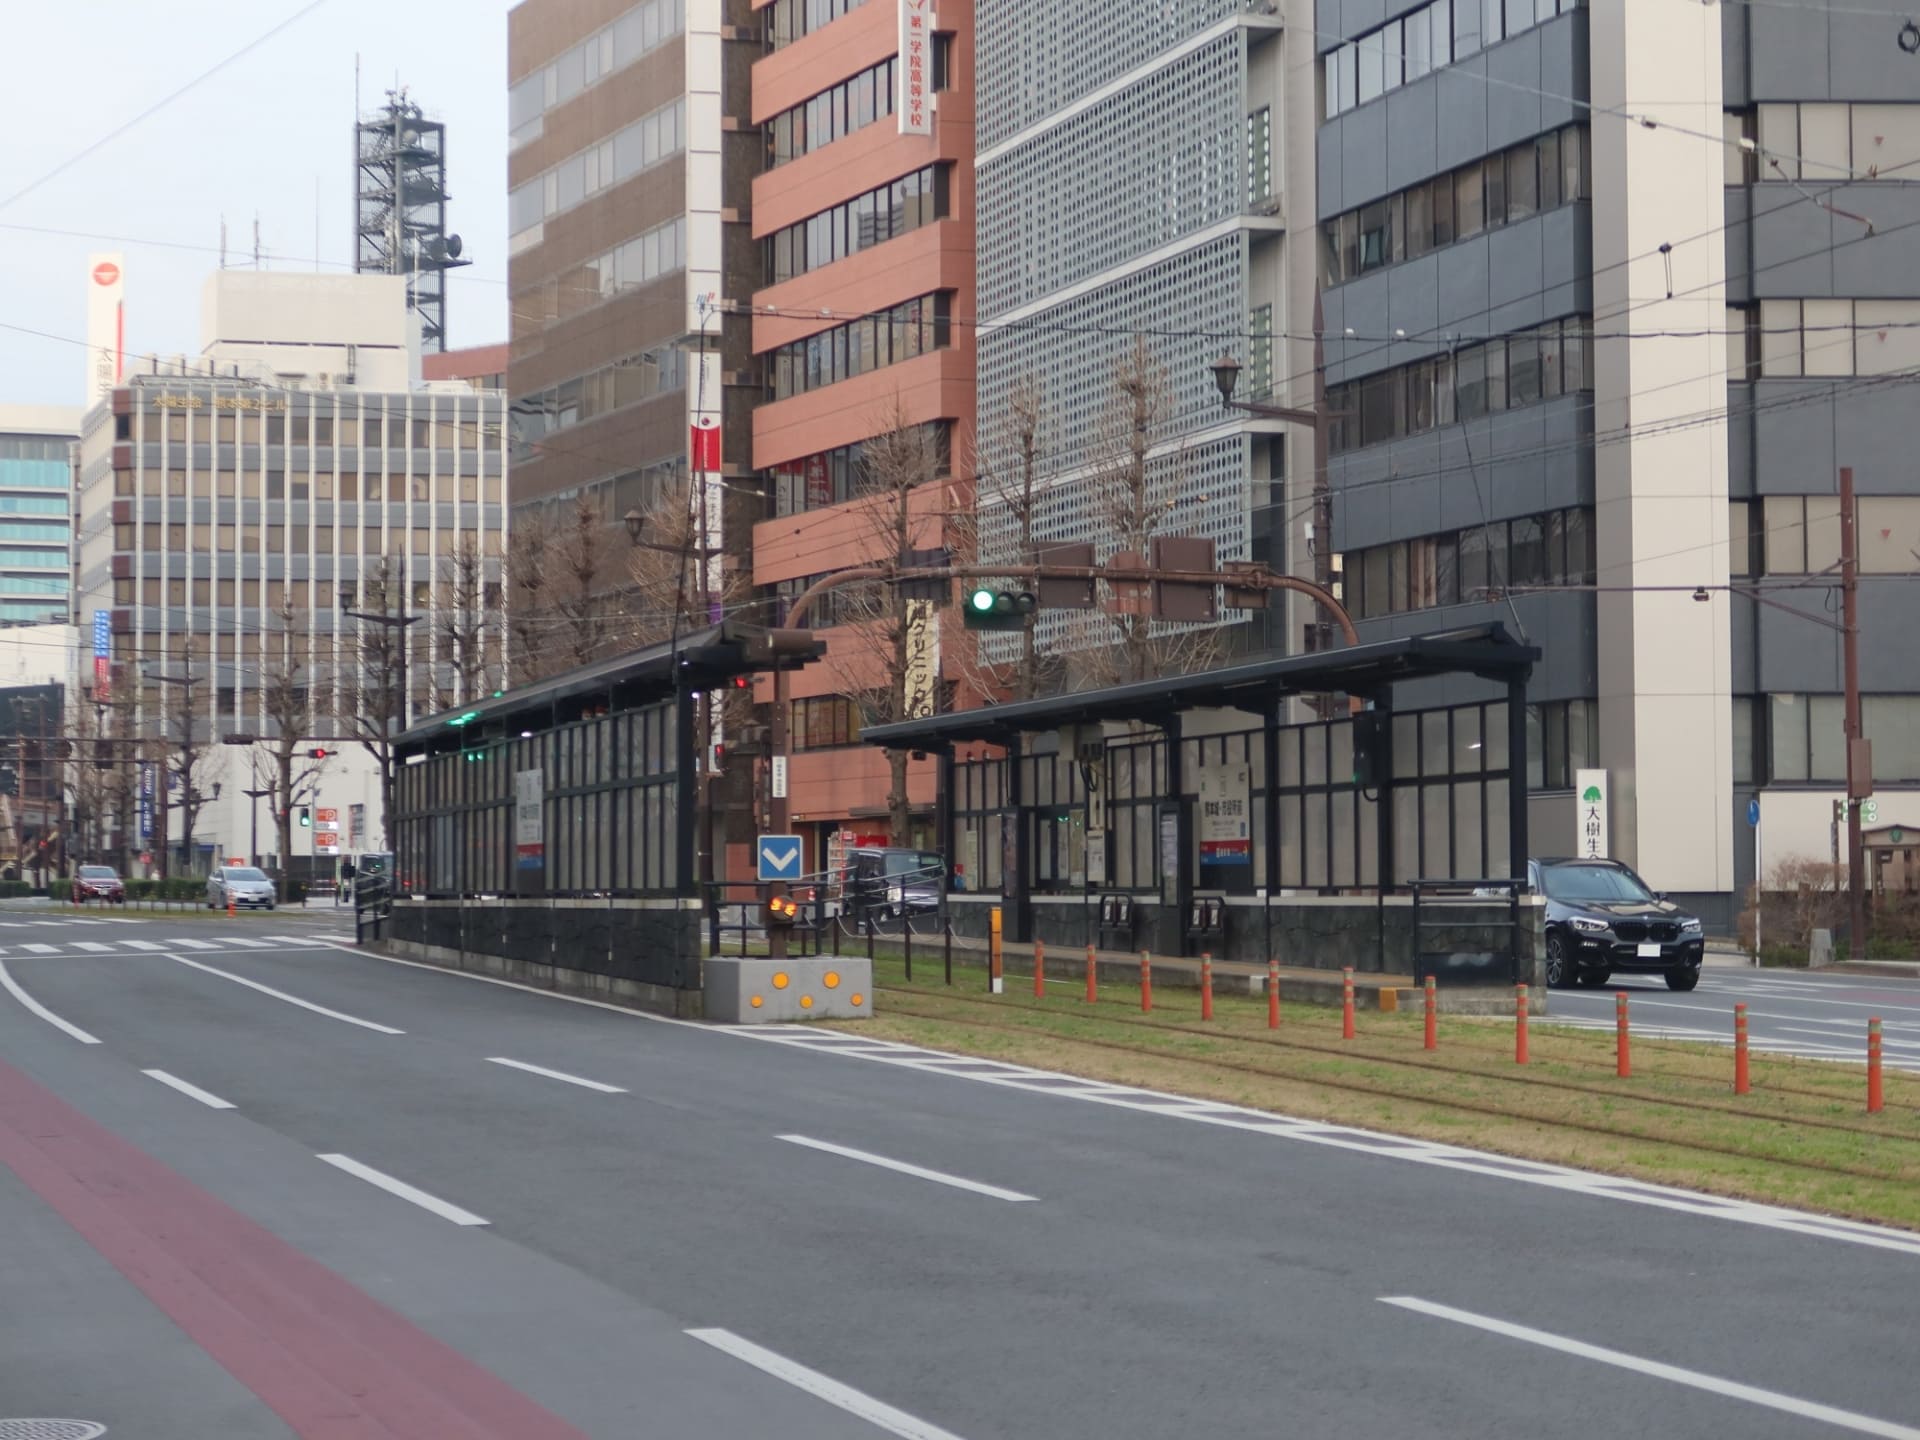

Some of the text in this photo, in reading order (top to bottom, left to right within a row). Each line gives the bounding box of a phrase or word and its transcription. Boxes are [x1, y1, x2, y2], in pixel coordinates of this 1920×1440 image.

[910, 15, 923, 127] 第一学院高等学校
[1584, 806, 1600, 860] 大樹生
